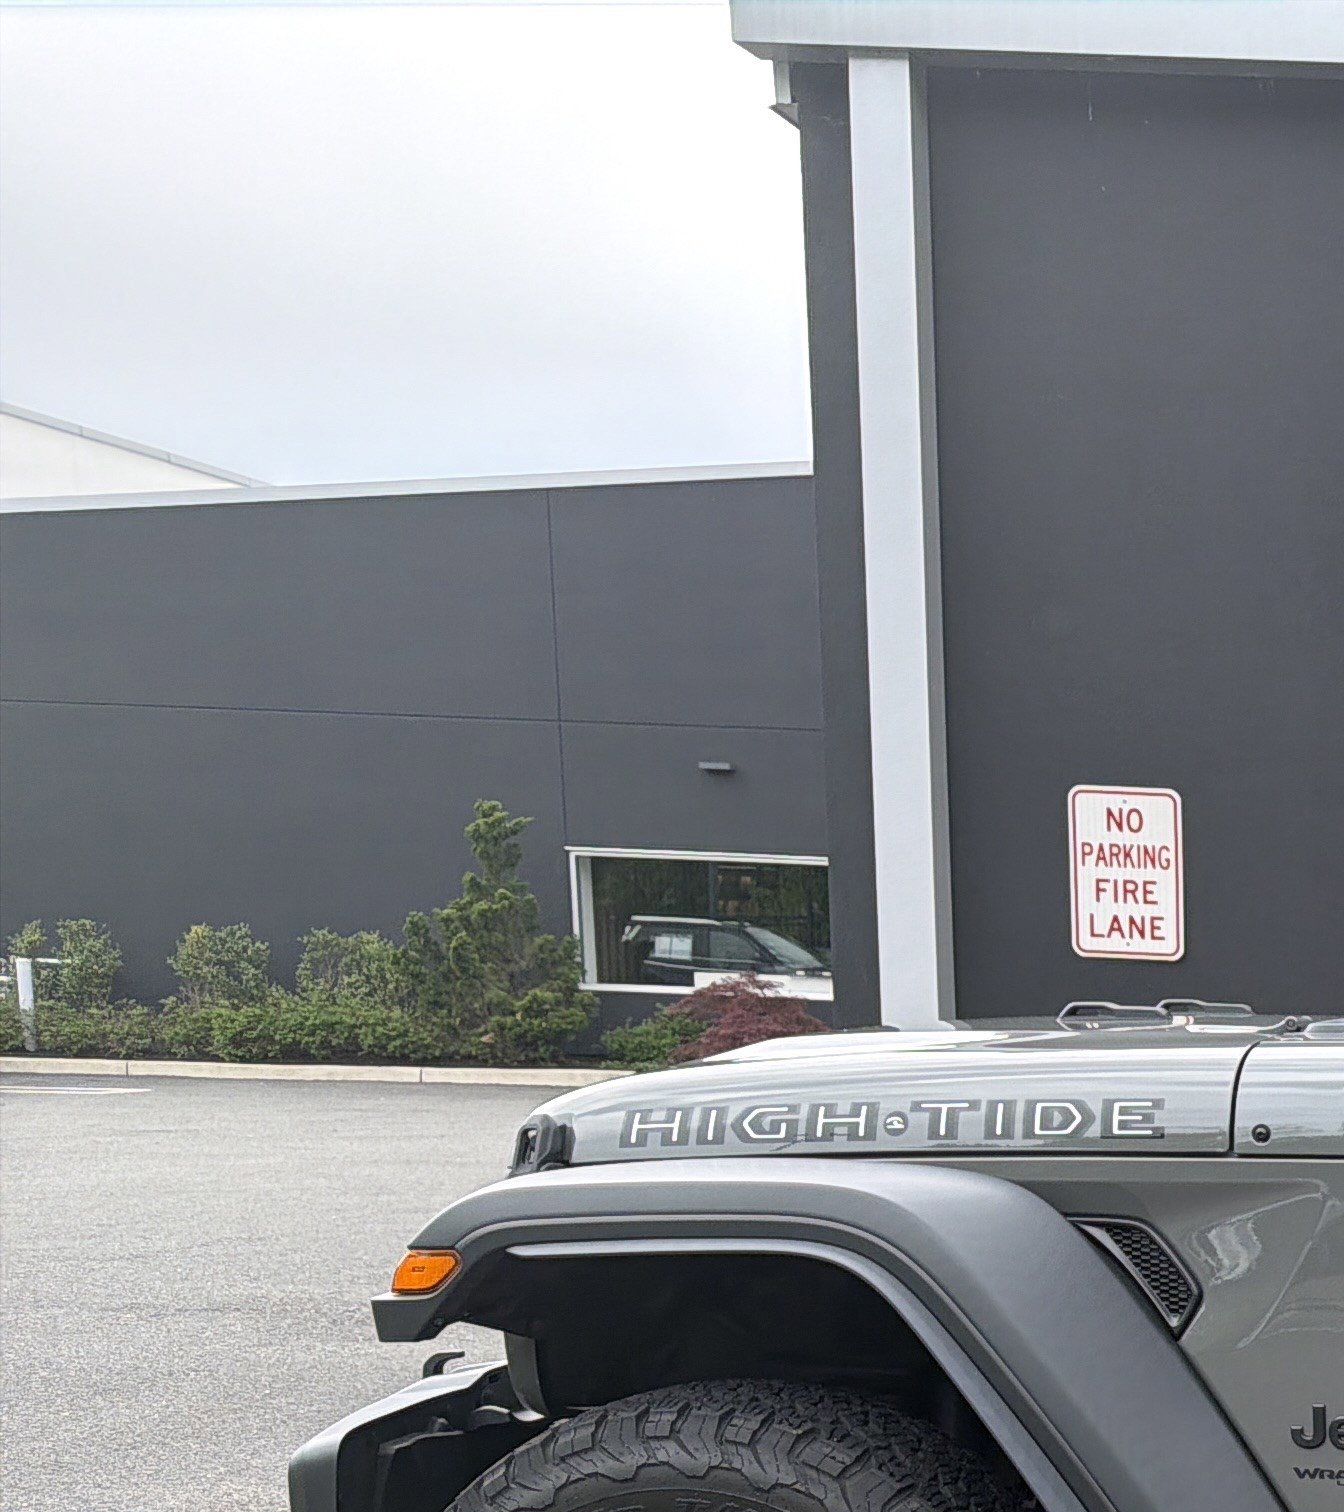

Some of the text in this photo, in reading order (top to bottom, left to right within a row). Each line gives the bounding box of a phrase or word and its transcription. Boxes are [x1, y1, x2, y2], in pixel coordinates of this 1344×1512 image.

[1105, 806, 1144, 834] NO
[1081, 841, 1171, 871] PARKING
[1095, 878, 1159, 905] FIRE
[1089, 913, 1166, 941] LANE
